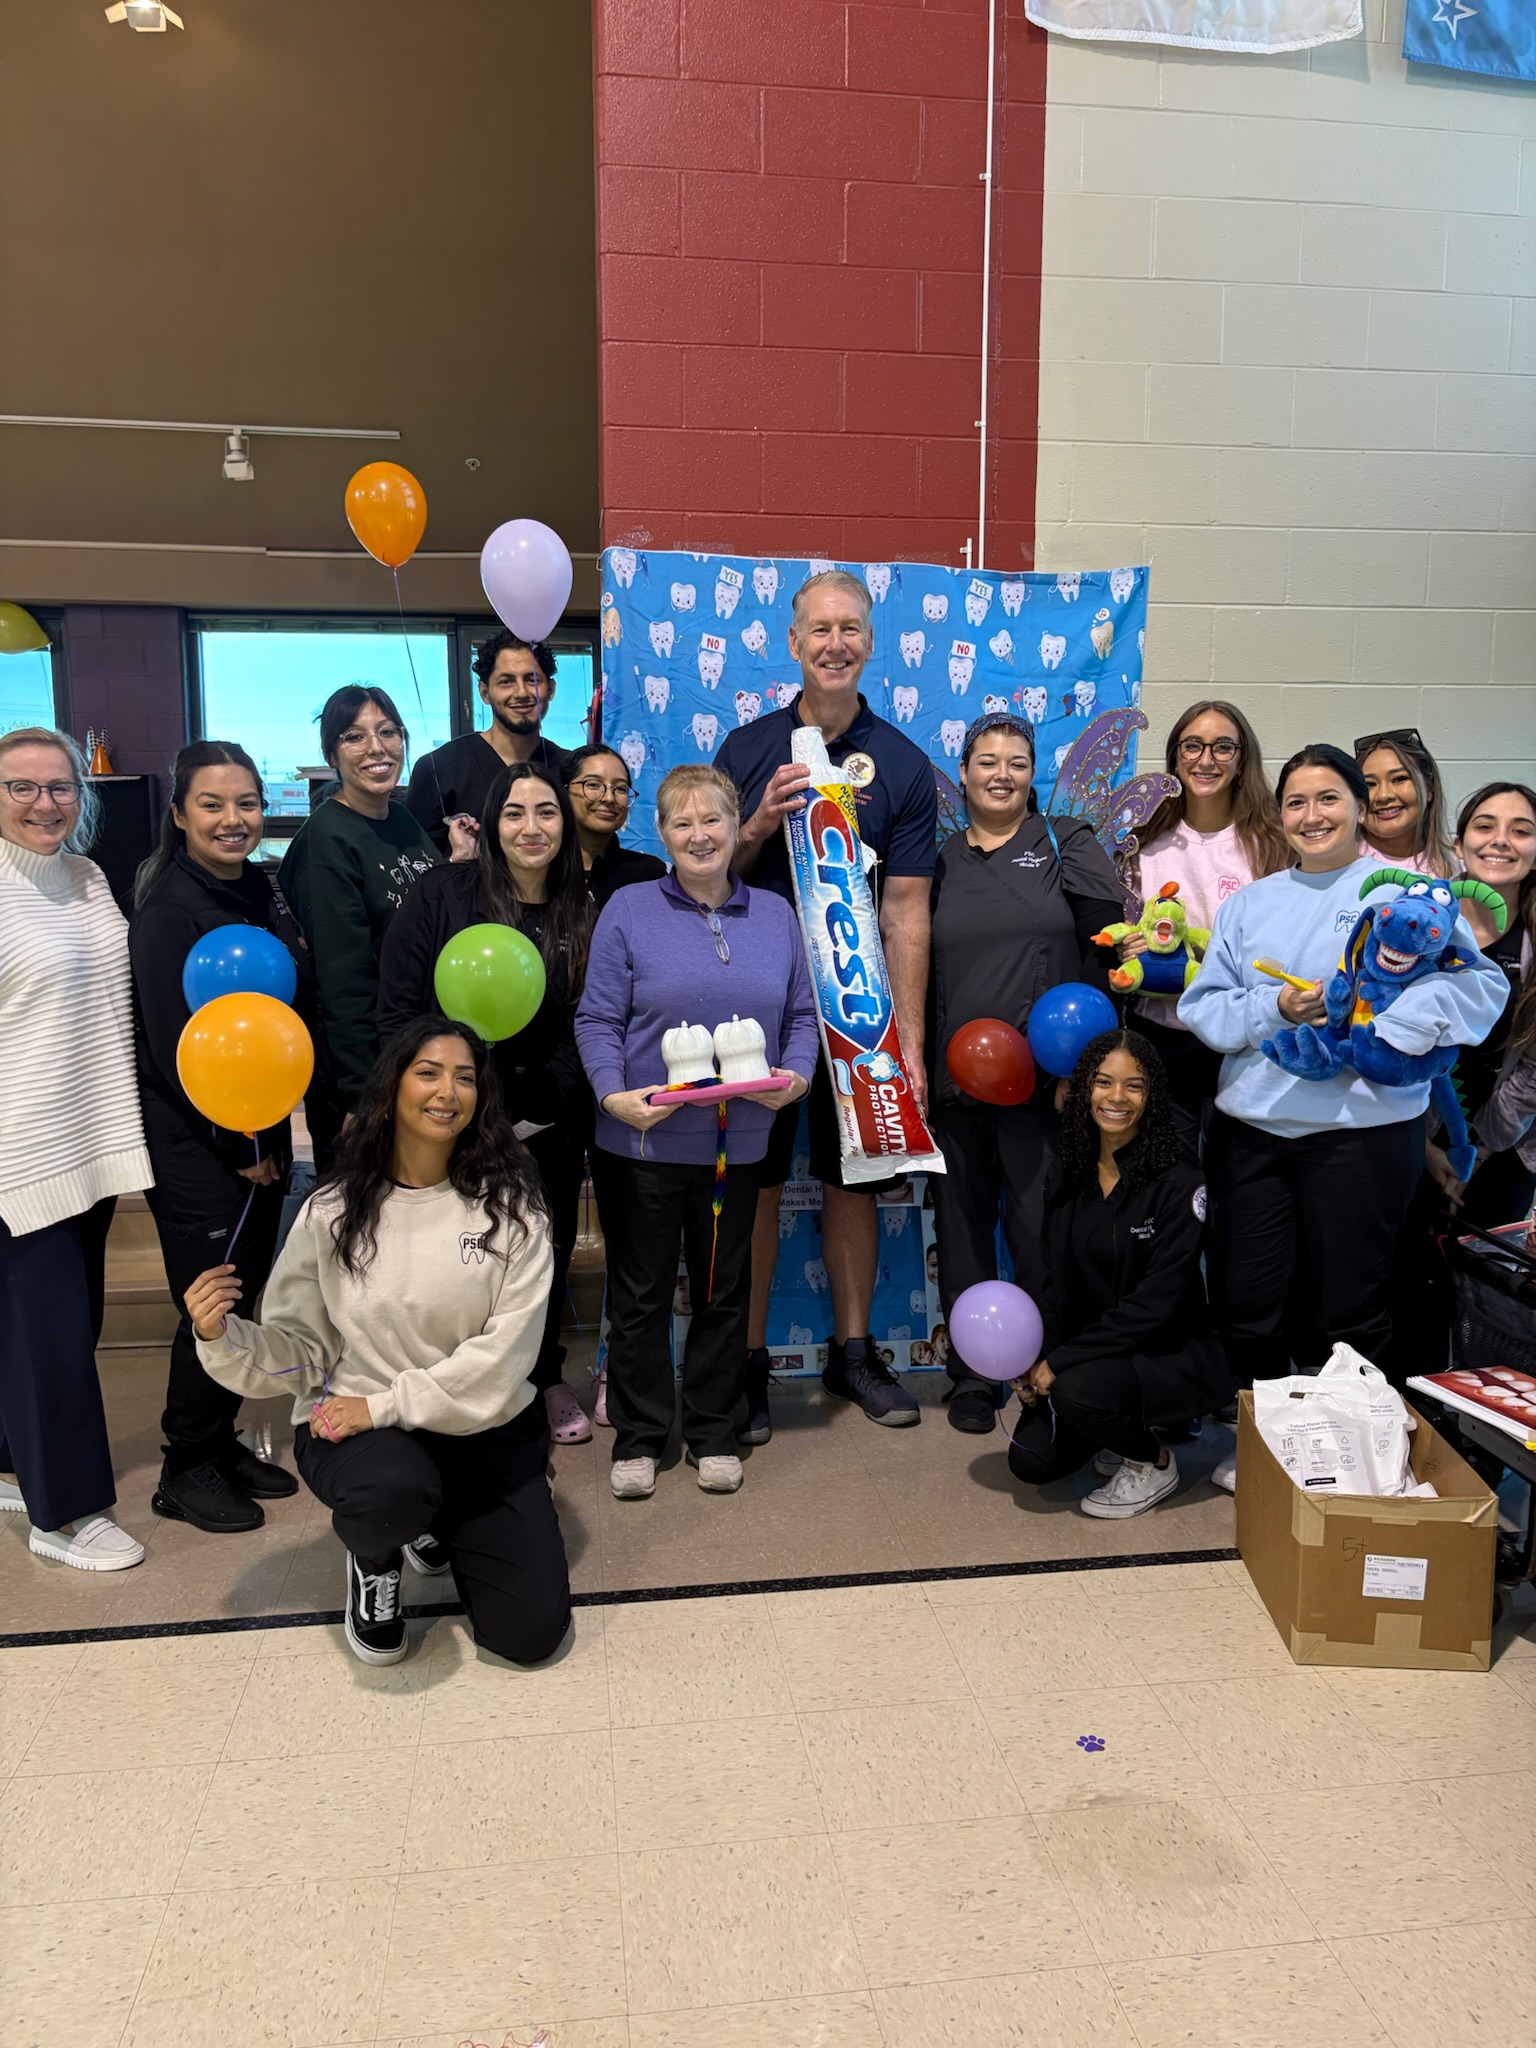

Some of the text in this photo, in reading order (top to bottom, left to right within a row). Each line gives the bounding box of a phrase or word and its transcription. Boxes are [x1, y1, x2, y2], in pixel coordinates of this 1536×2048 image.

[724, 568, 739, 585] YES
[974, 581, 989, 597] YES
[706, 637, 720, 650] NO
[956, 643, 970, 656] NO
[820, 786, 837, 801] Same
[791, 820, 802, 865] TOOTHPASTE
[796, 819, 807, 854] FLUORIDE
[1221, 880, 1237, 891] PSC
[810, 799, 881, 1022] Crest
[1339, 914, 1357, 924] PSC
[843, 1105, 855, 1142] Regular
[867, 1084, 890, 1156] PROTECTION
[878, 1084, 908, 1155] CAVITY
[784, 1185, 813, 1194] Dental
[780, 1198, 806, 1207] Makes
[463, 1238, 484, 1250] PSC
